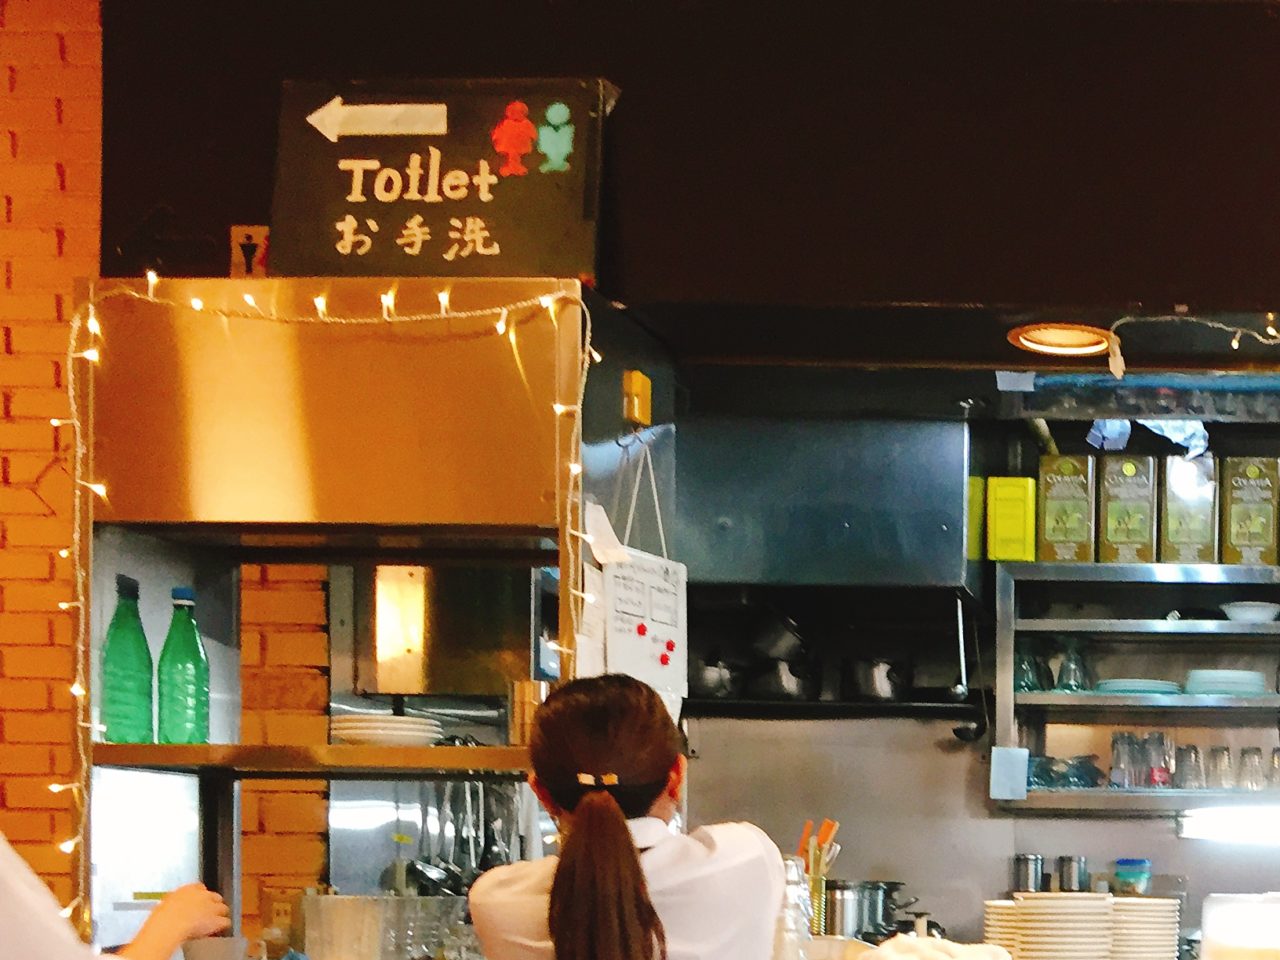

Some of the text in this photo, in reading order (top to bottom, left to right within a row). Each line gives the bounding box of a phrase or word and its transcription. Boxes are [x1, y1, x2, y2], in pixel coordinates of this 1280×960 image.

[337, 145, 499, 203] Toilet
[334, 214, 501, 261] お手洗
